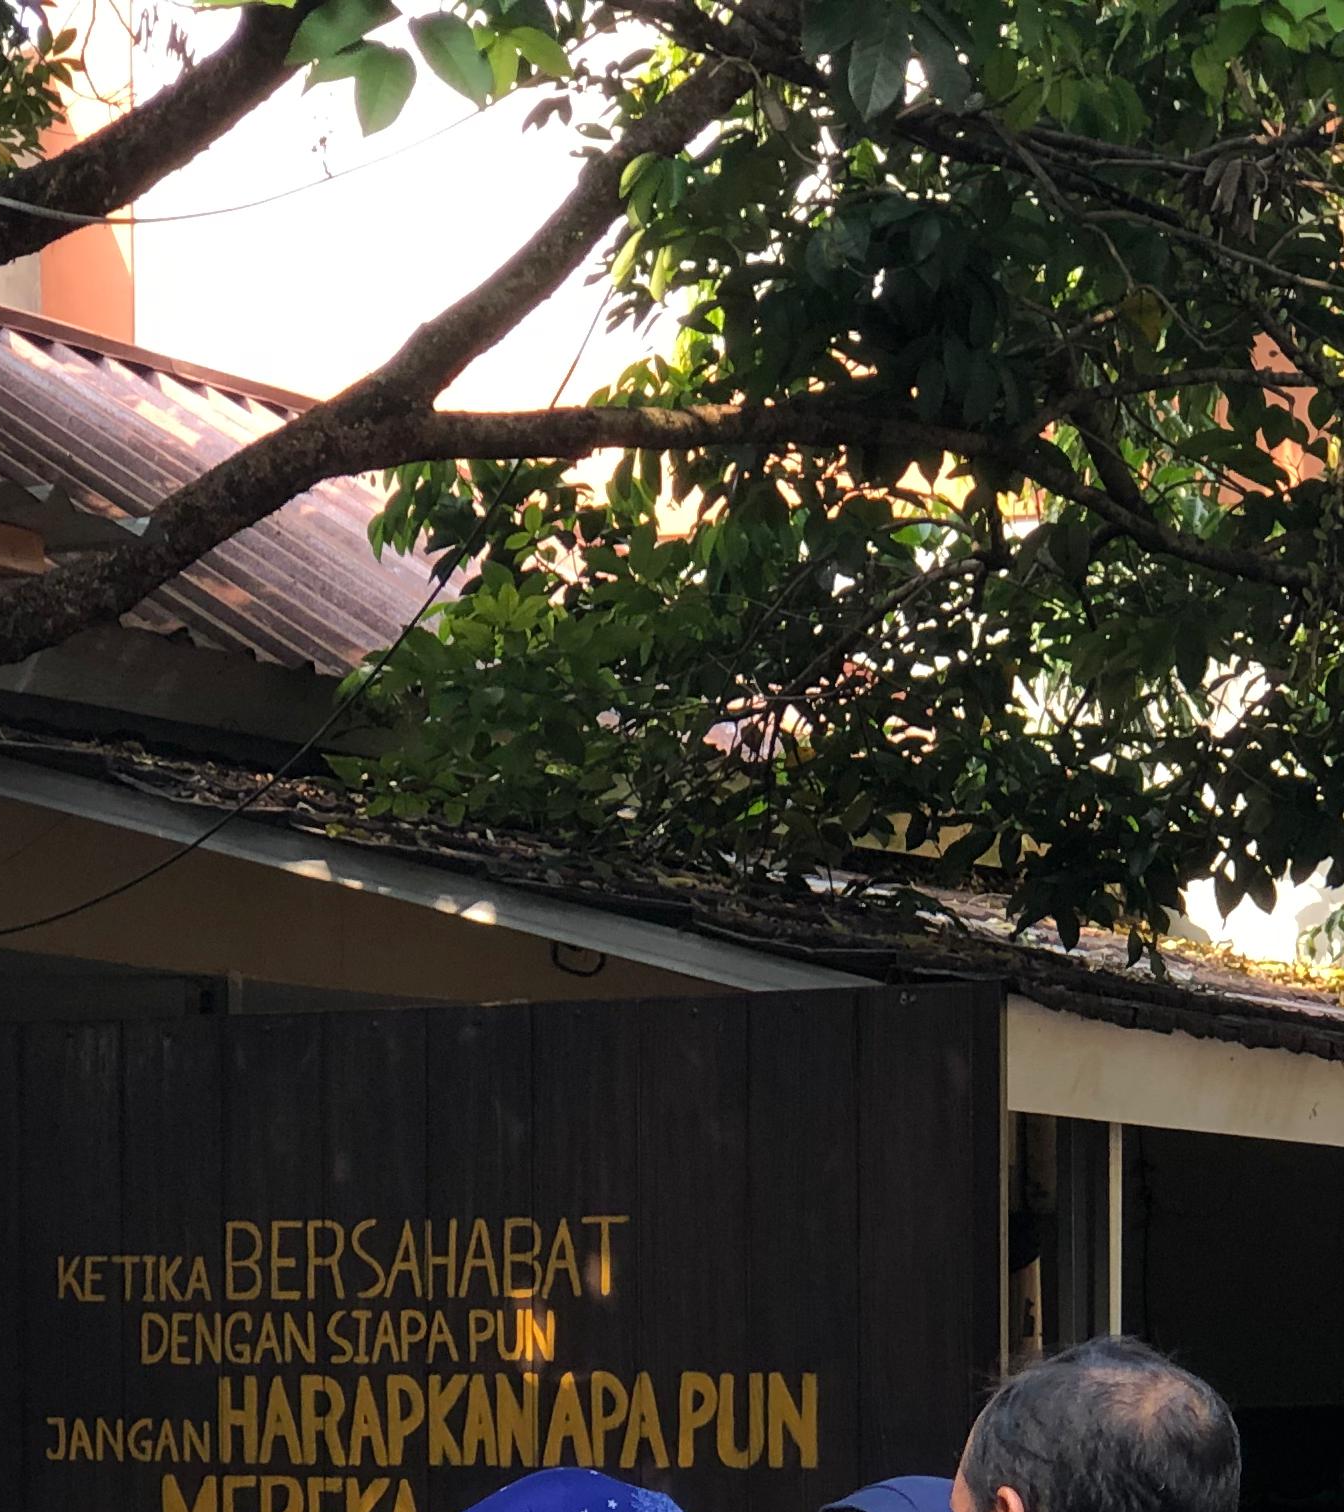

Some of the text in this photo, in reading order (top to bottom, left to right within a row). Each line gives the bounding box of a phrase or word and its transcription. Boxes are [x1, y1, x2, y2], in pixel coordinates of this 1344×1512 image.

[57, 1214, 630, 1303] KETIKA BERSAHABAT
[140, 1308, 556, 1366] DENGAN SIAPA PUN
[45, 1416, 211, 1464] JANGAN
[217, 1371, 540, 1469] HARAPKAN
